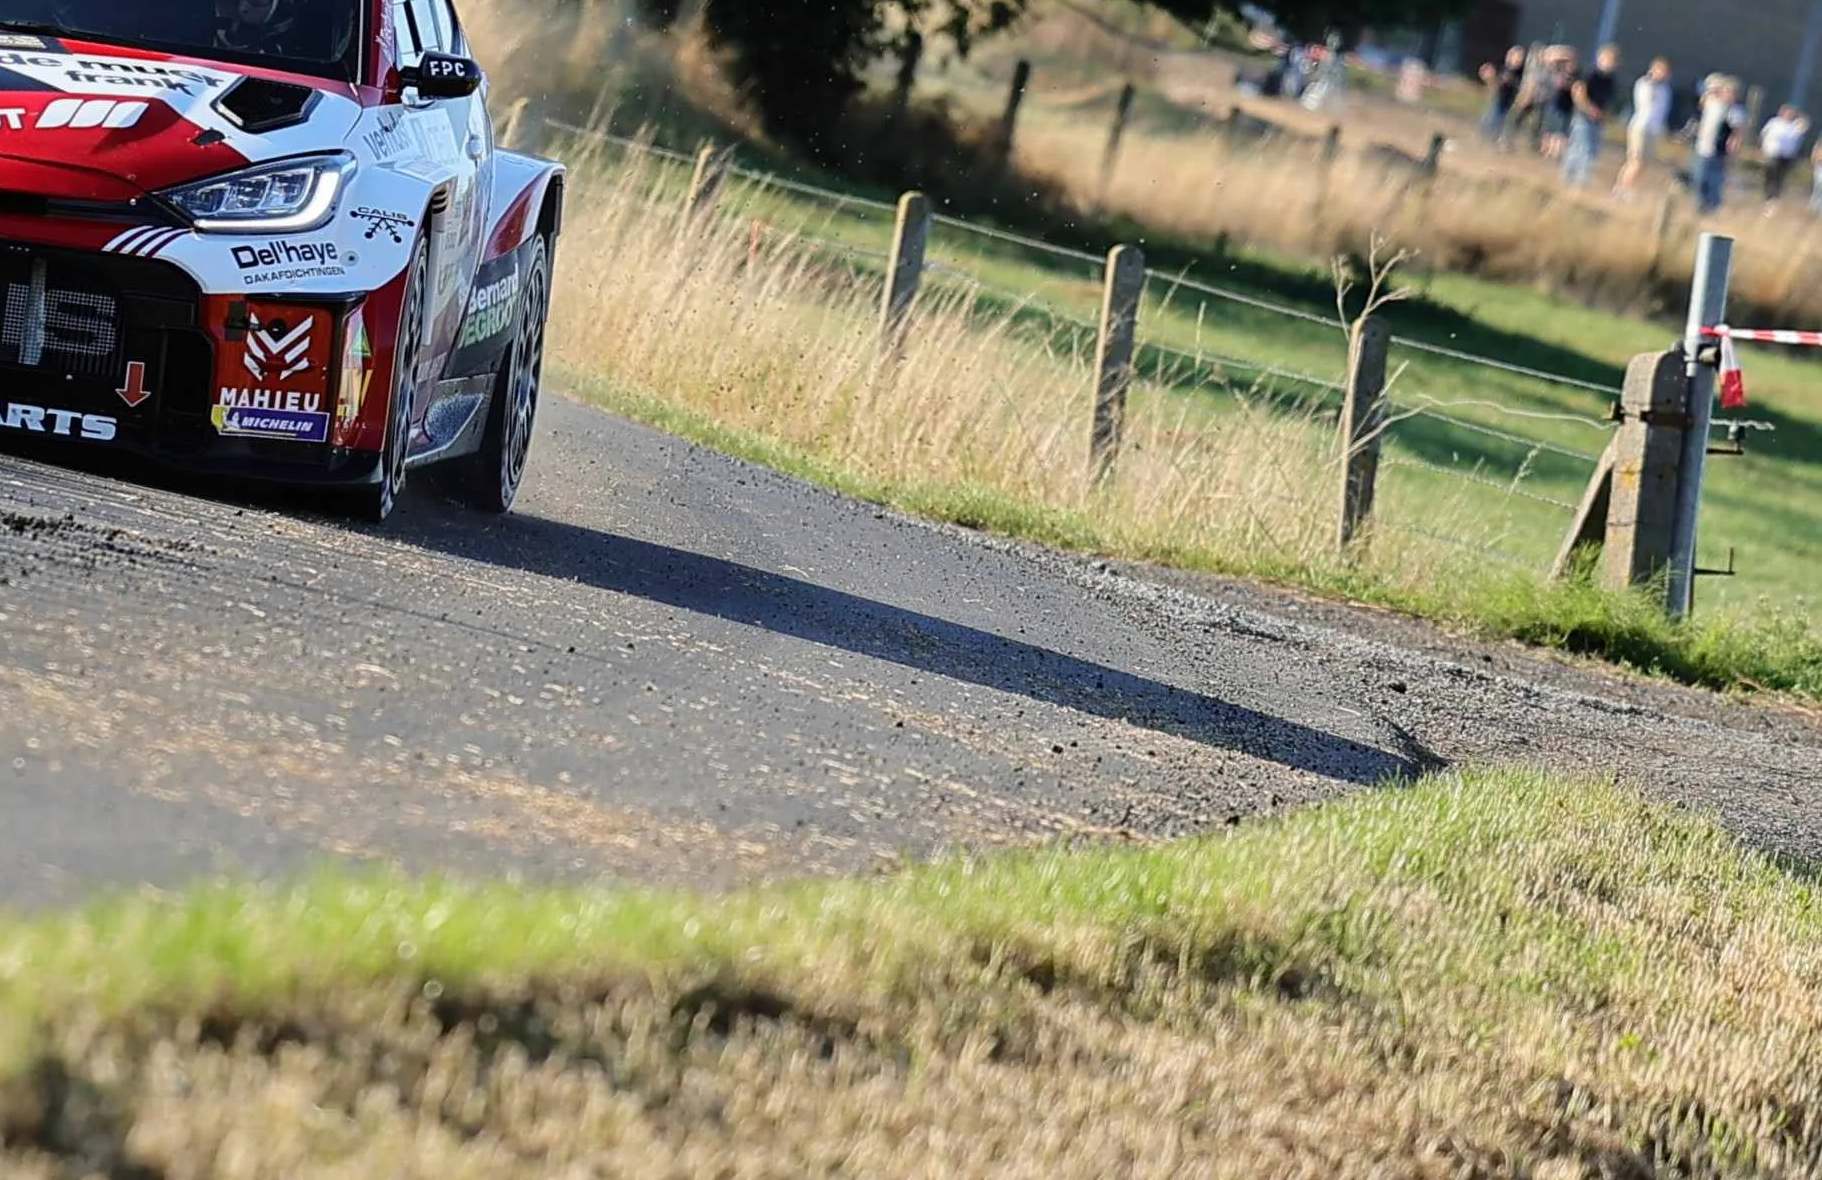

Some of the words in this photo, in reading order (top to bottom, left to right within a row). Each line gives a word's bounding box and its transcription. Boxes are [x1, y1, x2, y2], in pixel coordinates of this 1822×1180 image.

[65, 70, 195, 97] frank
[357, 206, 408, 220] CALIS
[231, 240, 338, 269] Del'haye
[243, 266, 346, 285] DAKAFDICHTINGEN
[219, 387, 320, 412] MAHIEU
[242, 417, 313, 432] MICHELIN
